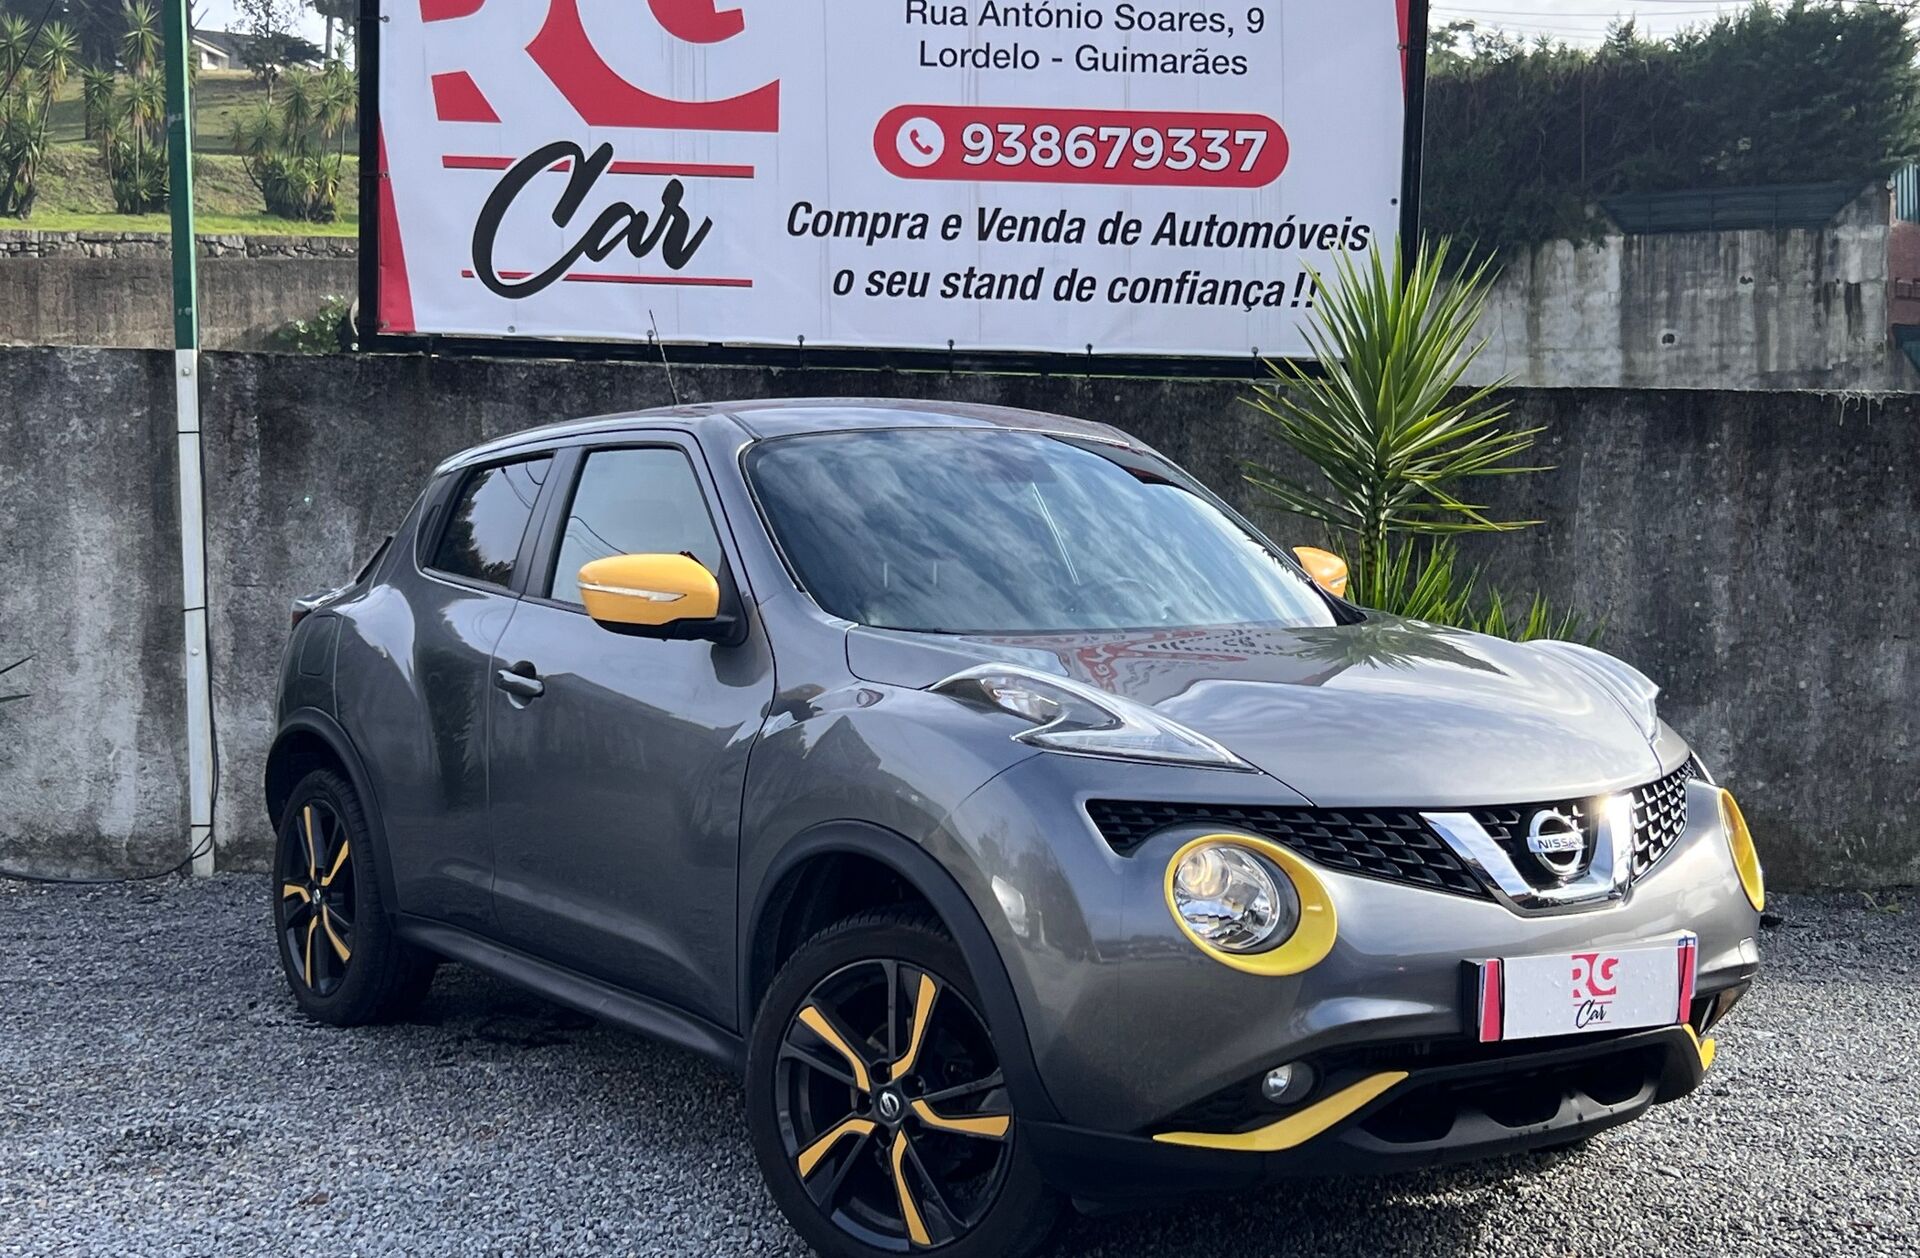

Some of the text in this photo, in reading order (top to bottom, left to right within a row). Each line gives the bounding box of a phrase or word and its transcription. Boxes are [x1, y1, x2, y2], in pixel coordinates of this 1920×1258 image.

[906, 0, 1266, 38] Rua António Soares, 9
[920, 40, 1040, 70] Lordelo
[1075, 44, 1248, 76] Guimarães
[961, 121, 1268, 173] 938679337
[472, 141, 713, 299] Car
[787, 201, 1371, 252] Compra e Venda de Automóveis
[833, 269, 855, 296] o
[864, 271, 931, 298] seu
[940, 266, 1045, 301] stand
[1053, 268, 1097, 303] de
[1571, 953, 1619, 998] RG
[1576, 999, 1607, 1029] Car
